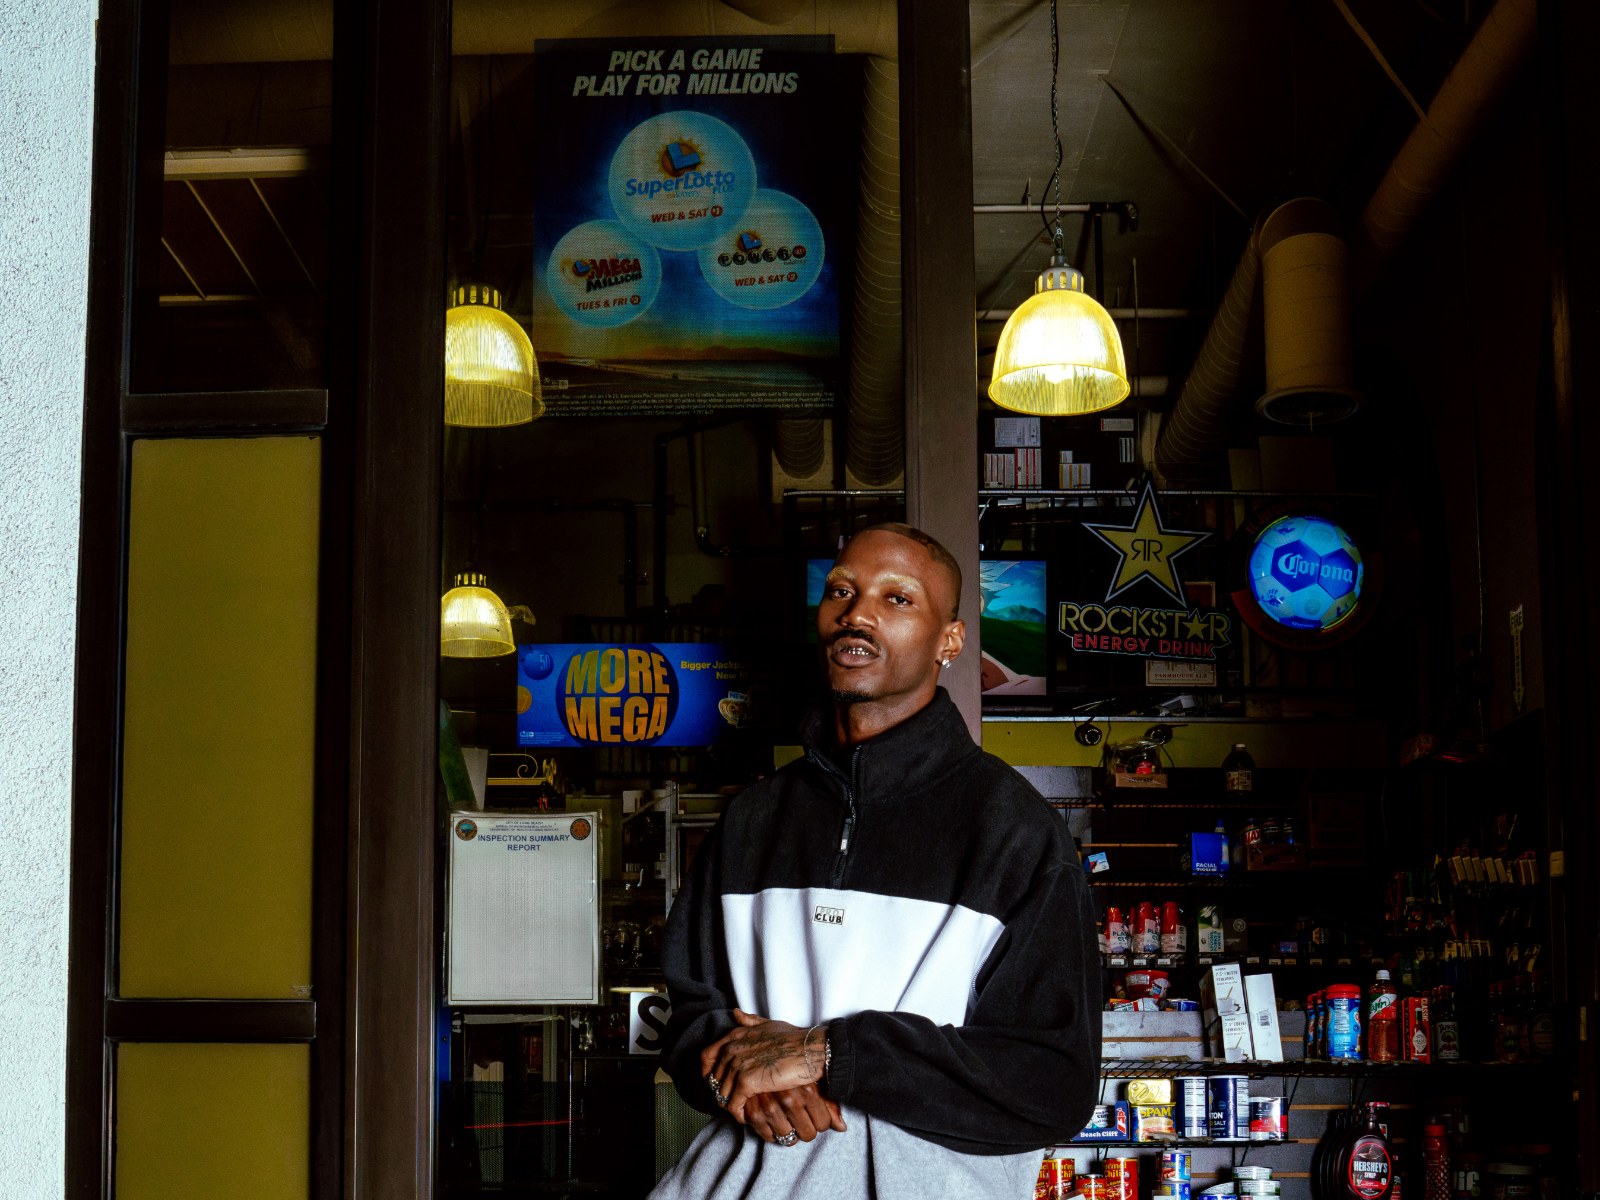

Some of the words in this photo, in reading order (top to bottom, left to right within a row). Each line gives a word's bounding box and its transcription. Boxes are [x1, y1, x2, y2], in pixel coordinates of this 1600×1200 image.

[608, 50, 666, 71] PICK
[667, 49, 685, 70] A
[692, 48, 763, 70] GAME
[572, 74, 633, 97] PLAY
[635, 73, 681, 95] FOR
[686, 72, 799, 94] MILLIONS
[651, 211, 675, 223] WED
[679, 212, 686, 220] &
[689, 208, 709, 219] SAT
[734, 277, 756, 287] WED
[767, 273, 785, 283] SAT
[576, 300, 600, 310] TUES
[612, 298, 628, 306] FRI
[1278, 552, 1354, 583] Corona
[1073, 633, 1149, 652] ENERGY
[1158, 639, 1215, 657] DRINK
[565, 648, 671, 695] MORE
[680, 661, 711, 670] Bigger
[716, 671, 737, 680] New
[564, 696, 669, 743] MEGA
[815, 913, 842, 924] CLUB
[1140, 1106, 1173, 1118] SPAM
[1354, 1161, 1388, 1173] HERSHEY'S
